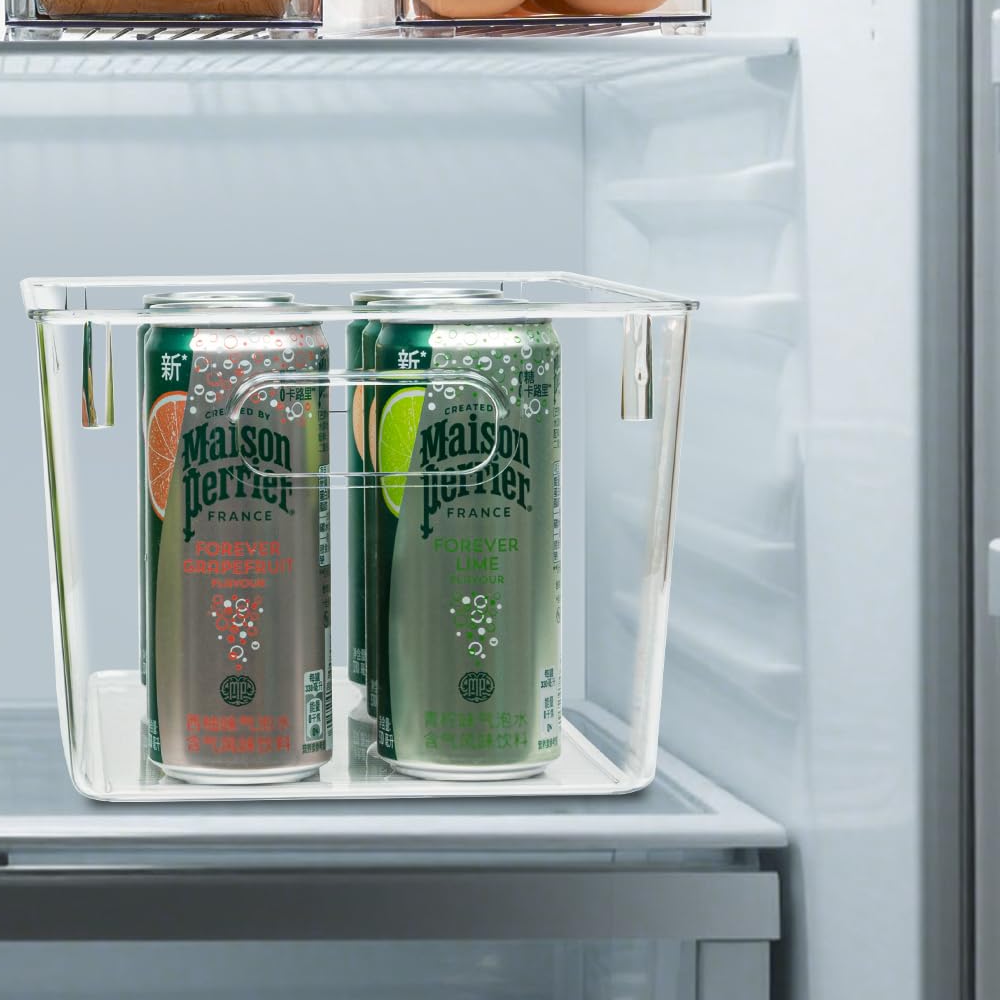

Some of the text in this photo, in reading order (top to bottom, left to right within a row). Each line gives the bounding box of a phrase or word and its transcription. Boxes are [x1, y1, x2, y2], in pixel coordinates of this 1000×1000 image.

[204, 407, 271, 420] CREED BY
[444, 403, 493, 415] CREATED
[181, 420, 292, 472] Maison
[420, 413, 530, 468] Maison
[208, 510, 272, 522] FRANCE
[447, 506, 511, 518] FRANCE
[195, 540, 281, 556] FOREVER
[433, 537, 519, 552] FOREVER
[183, 557, 294, 576] GRAPEFRUIT
[456, 556, 499, 571] LIME
